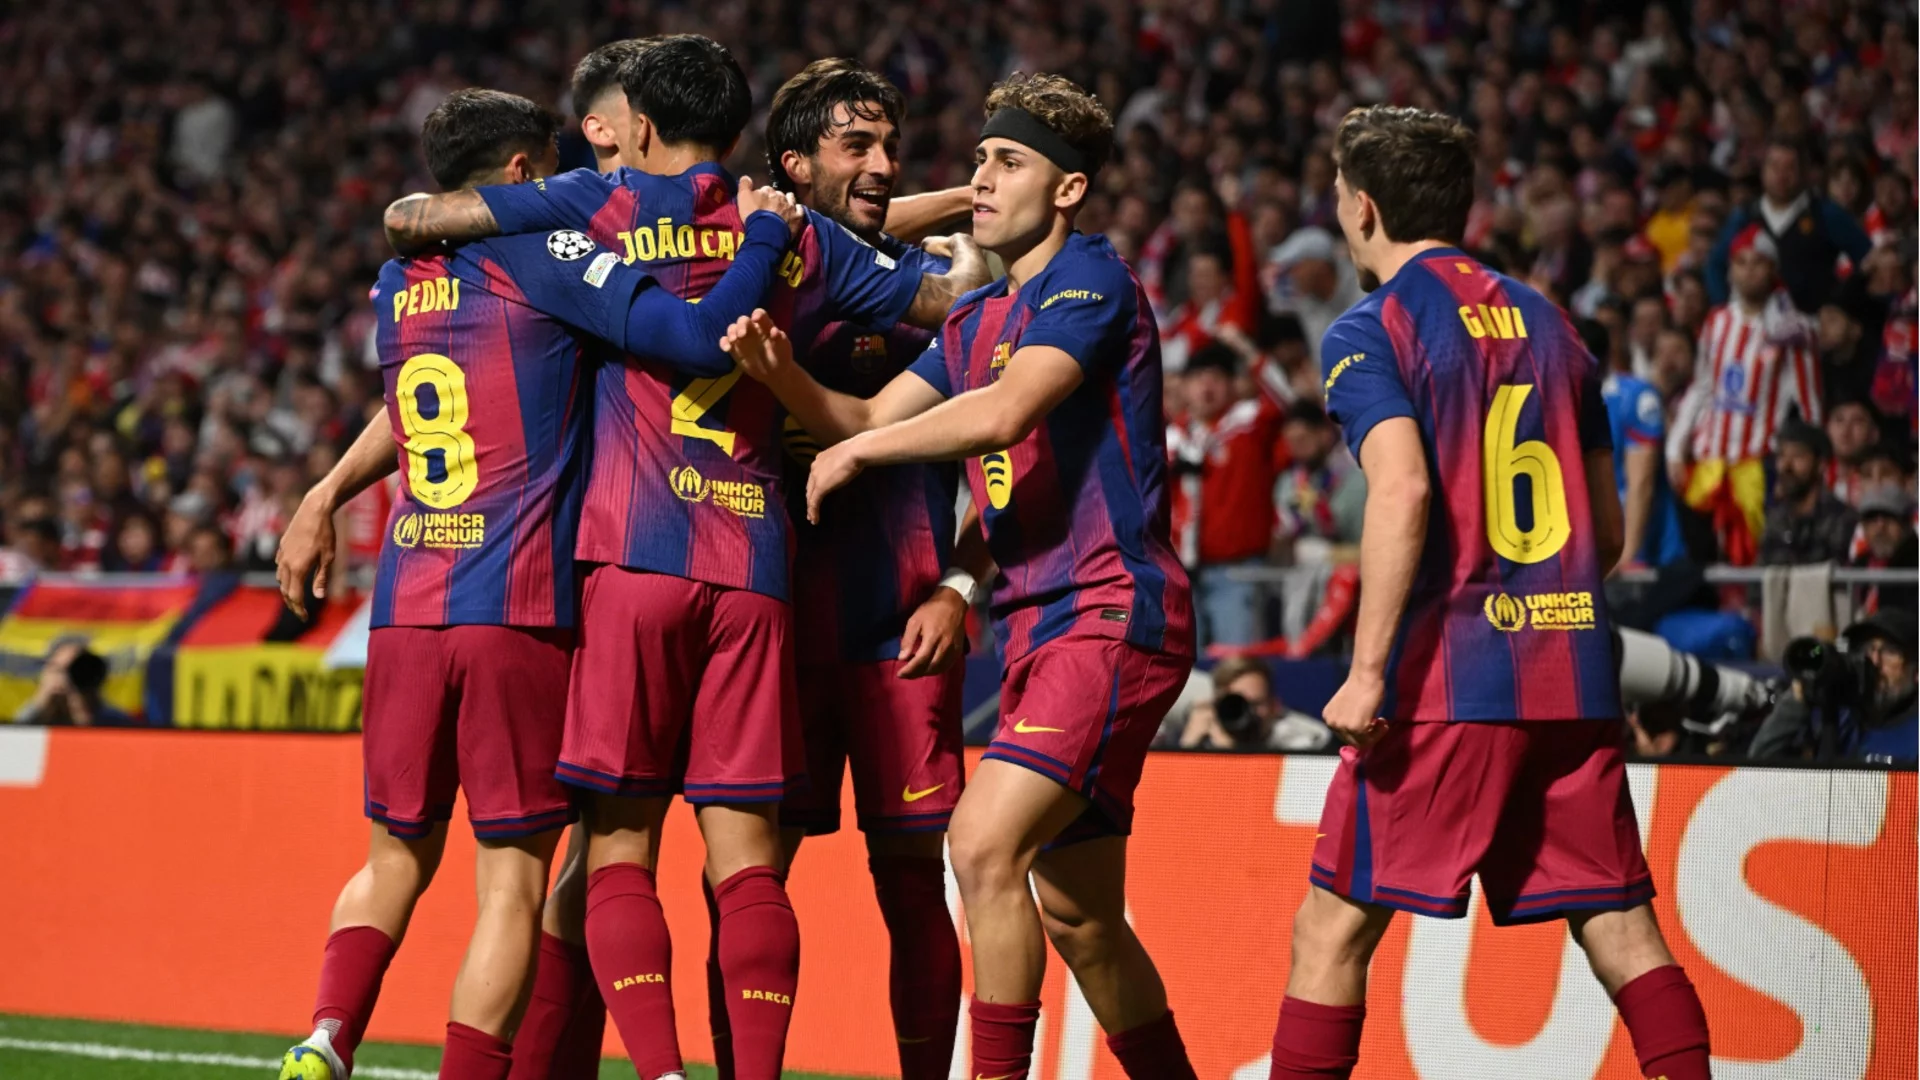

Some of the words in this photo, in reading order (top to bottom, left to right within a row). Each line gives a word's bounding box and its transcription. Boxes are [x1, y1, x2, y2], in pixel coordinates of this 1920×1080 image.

[617, 217, 696, 266] JOÃO
[701, 228, 805, 288] CALO
[393, 277, 460, 323] PEDRI
[1458, 303, 1528, 339] GAVI
[396, 353, 478, 509] 8
[1484, 384, 1571, 564] 6
[423, 528, 485, 542] ACNUR
[424, 513, 485, 528] UNHCR
[1524, 592, 1593, 610] UNHCR
[1530, 607, 1595, 624] ACNUR
